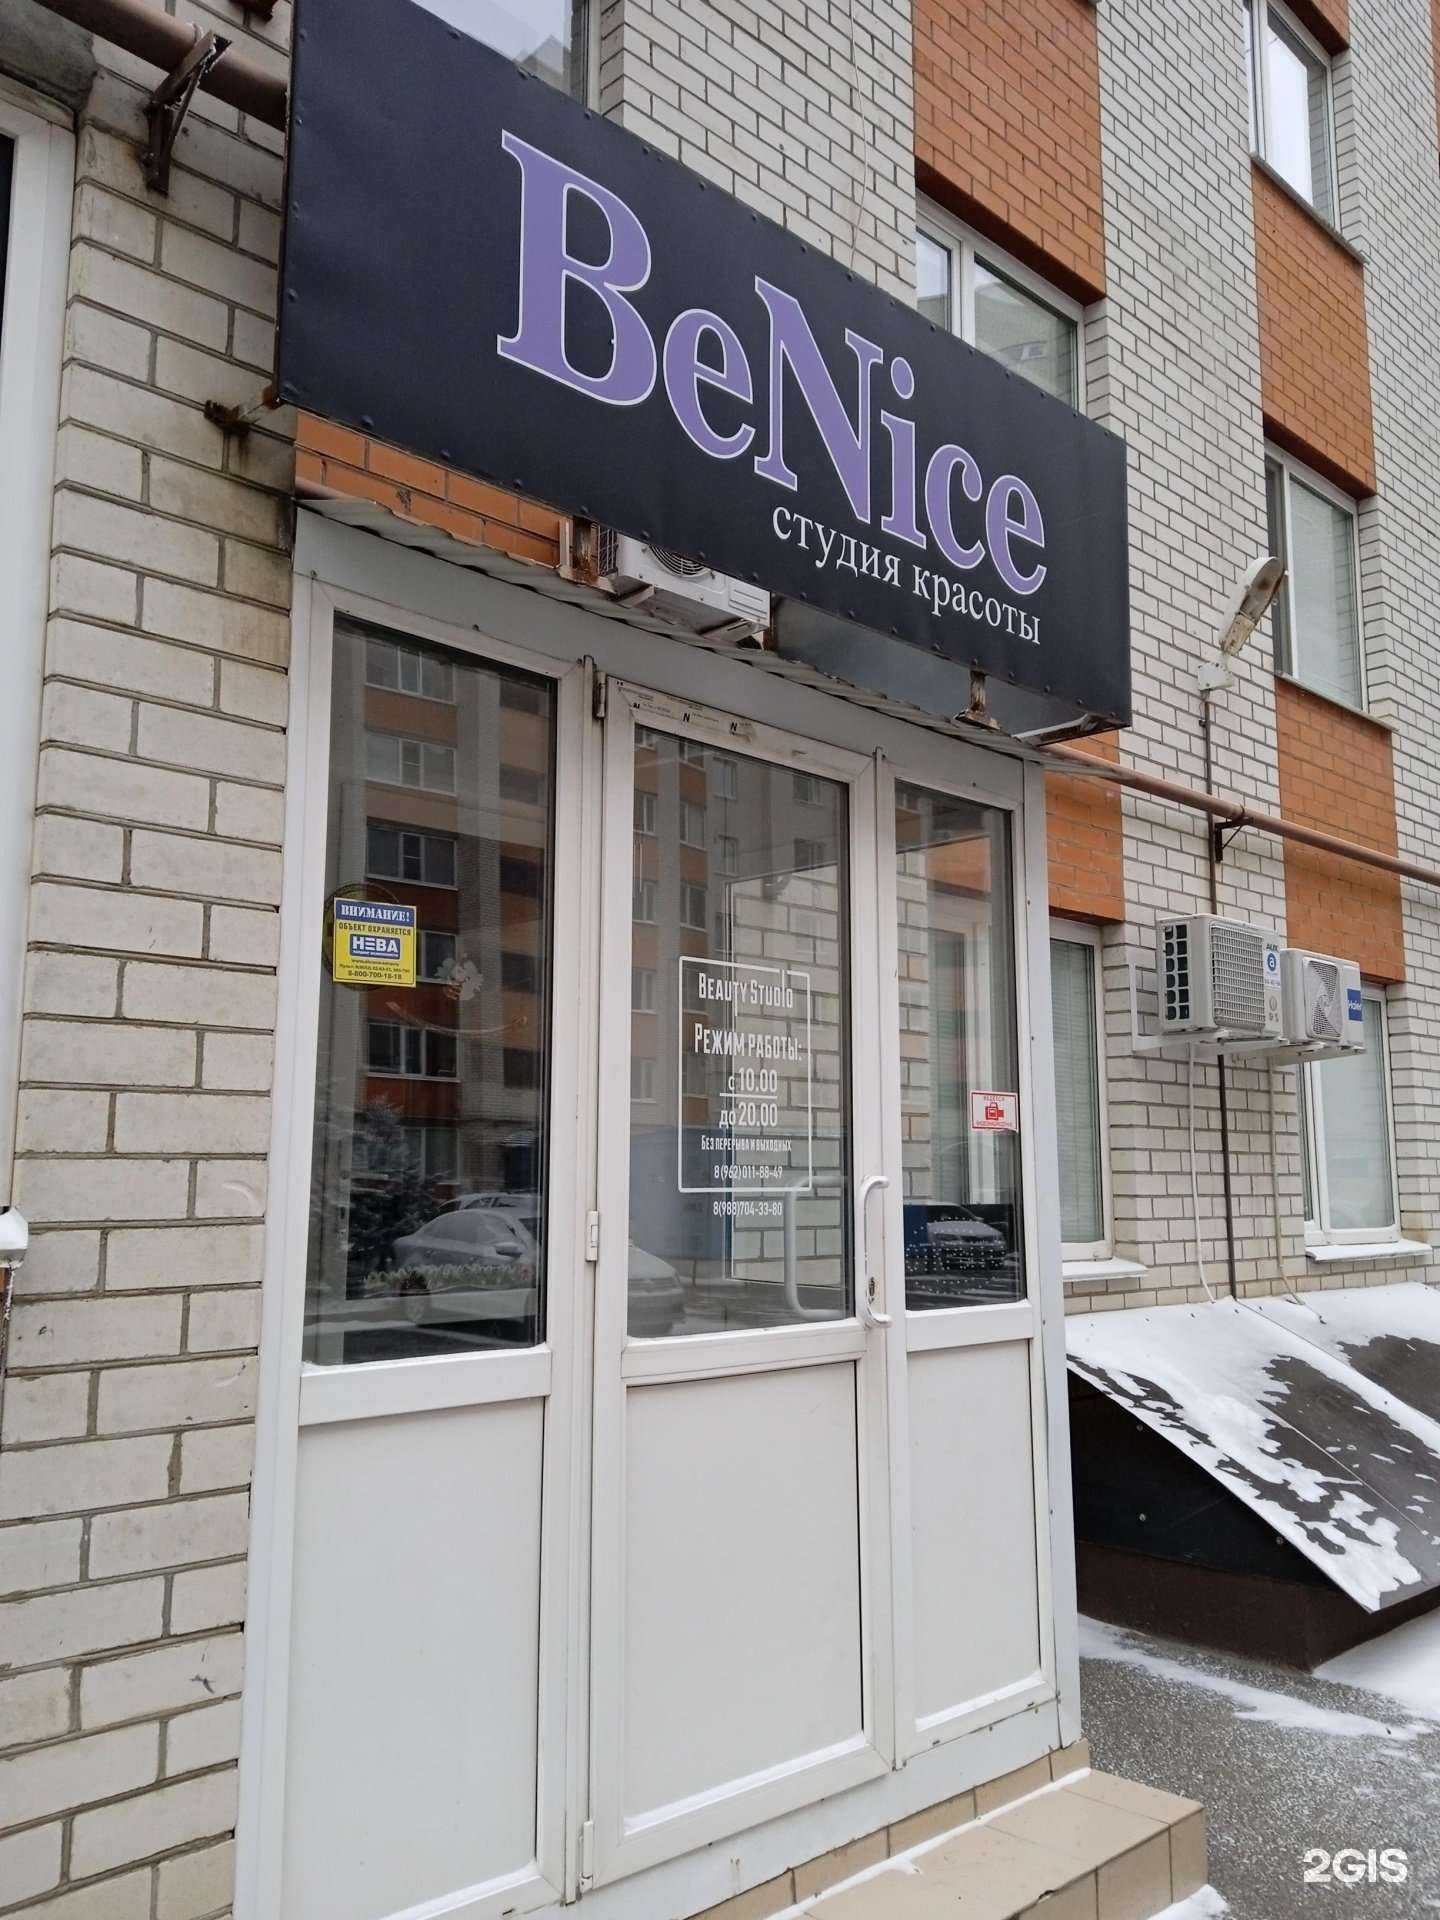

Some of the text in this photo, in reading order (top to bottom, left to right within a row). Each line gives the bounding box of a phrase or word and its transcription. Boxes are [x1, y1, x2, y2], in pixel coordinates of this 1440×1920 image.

[496, 128, 1048, 596] BeNice
[773, 505, 1041, 645] студия красоты
[341, 905, 410, 922] ВНИМАНИЕ!
[339, 921, 411, 936] ОБЪЕКТ ОХРАНЯЕТСЯ
[352, 936, 399, 953] НЕВА
[738, 1067, 778, 1092] 10.00
[719, 1101, 778, 1129] до 20.00
